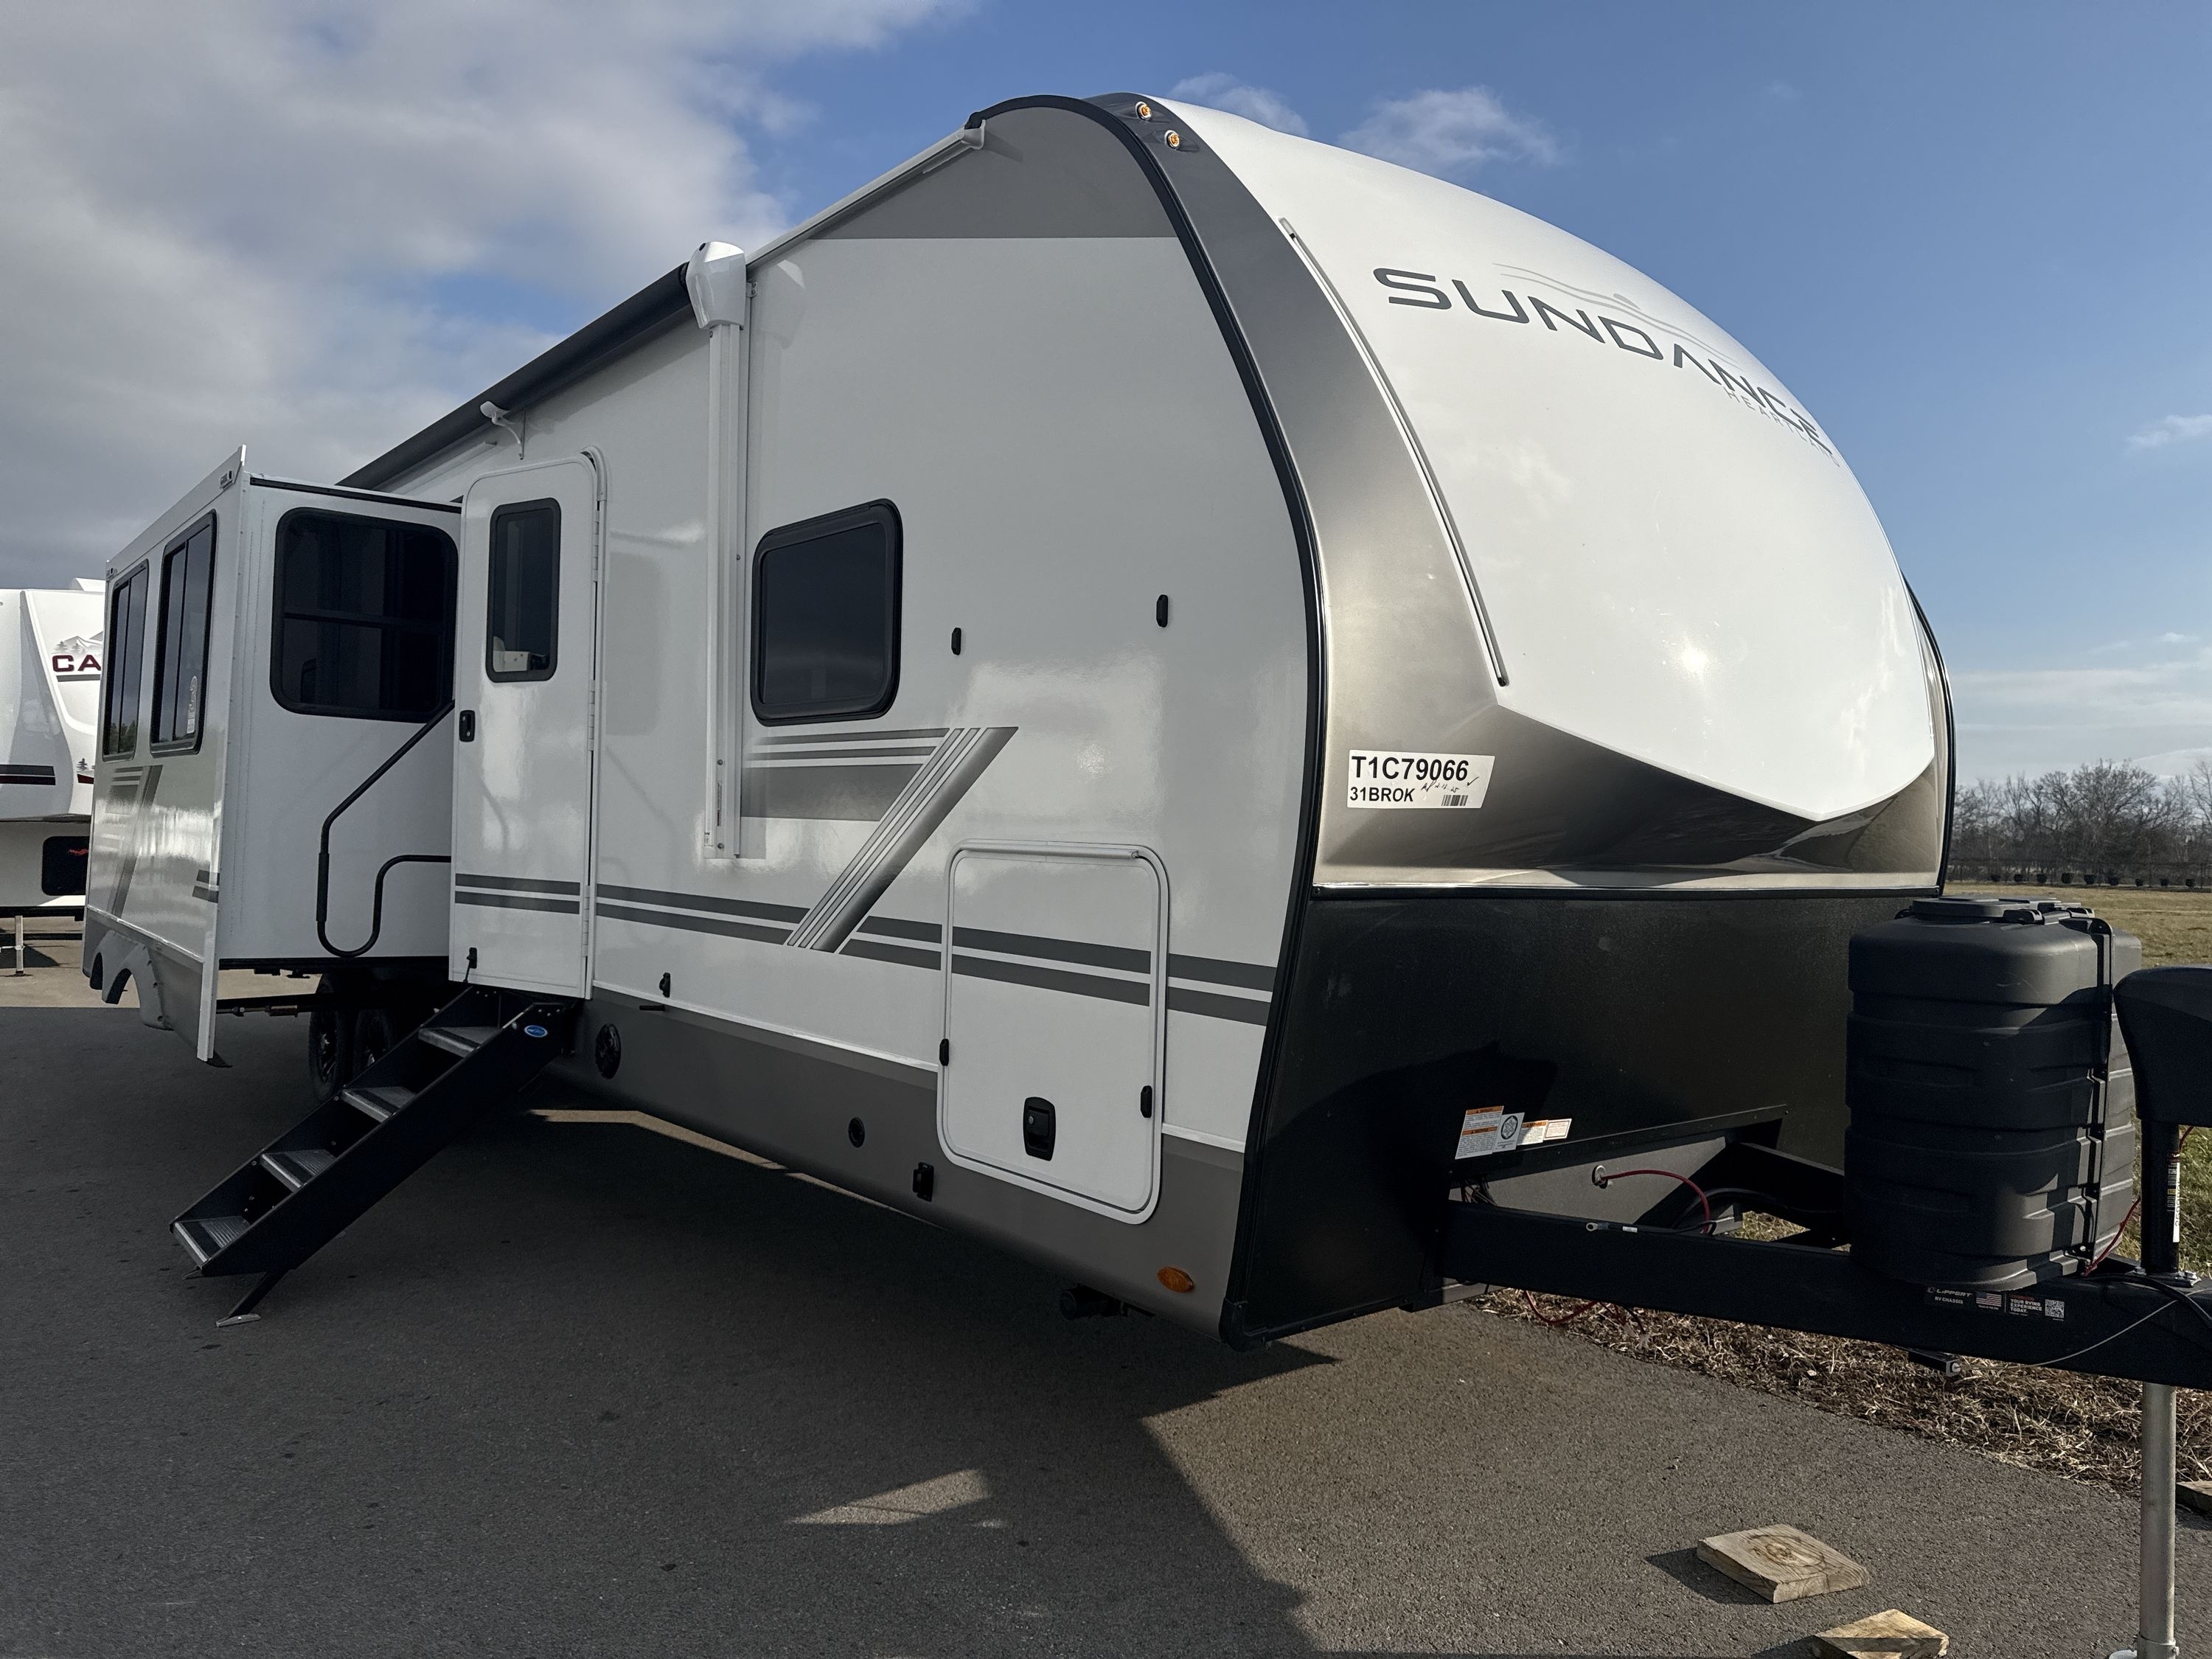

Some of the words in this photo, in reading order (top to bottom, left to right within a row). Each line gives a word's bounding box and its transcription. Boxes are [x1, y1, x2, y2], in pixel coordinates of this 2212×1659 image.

[1373, 268, 1833, 455] SUNDANCE
[1351, 756, 1470, 782] T1C79066
[1349, 786, 1416, 802] 31BROK
